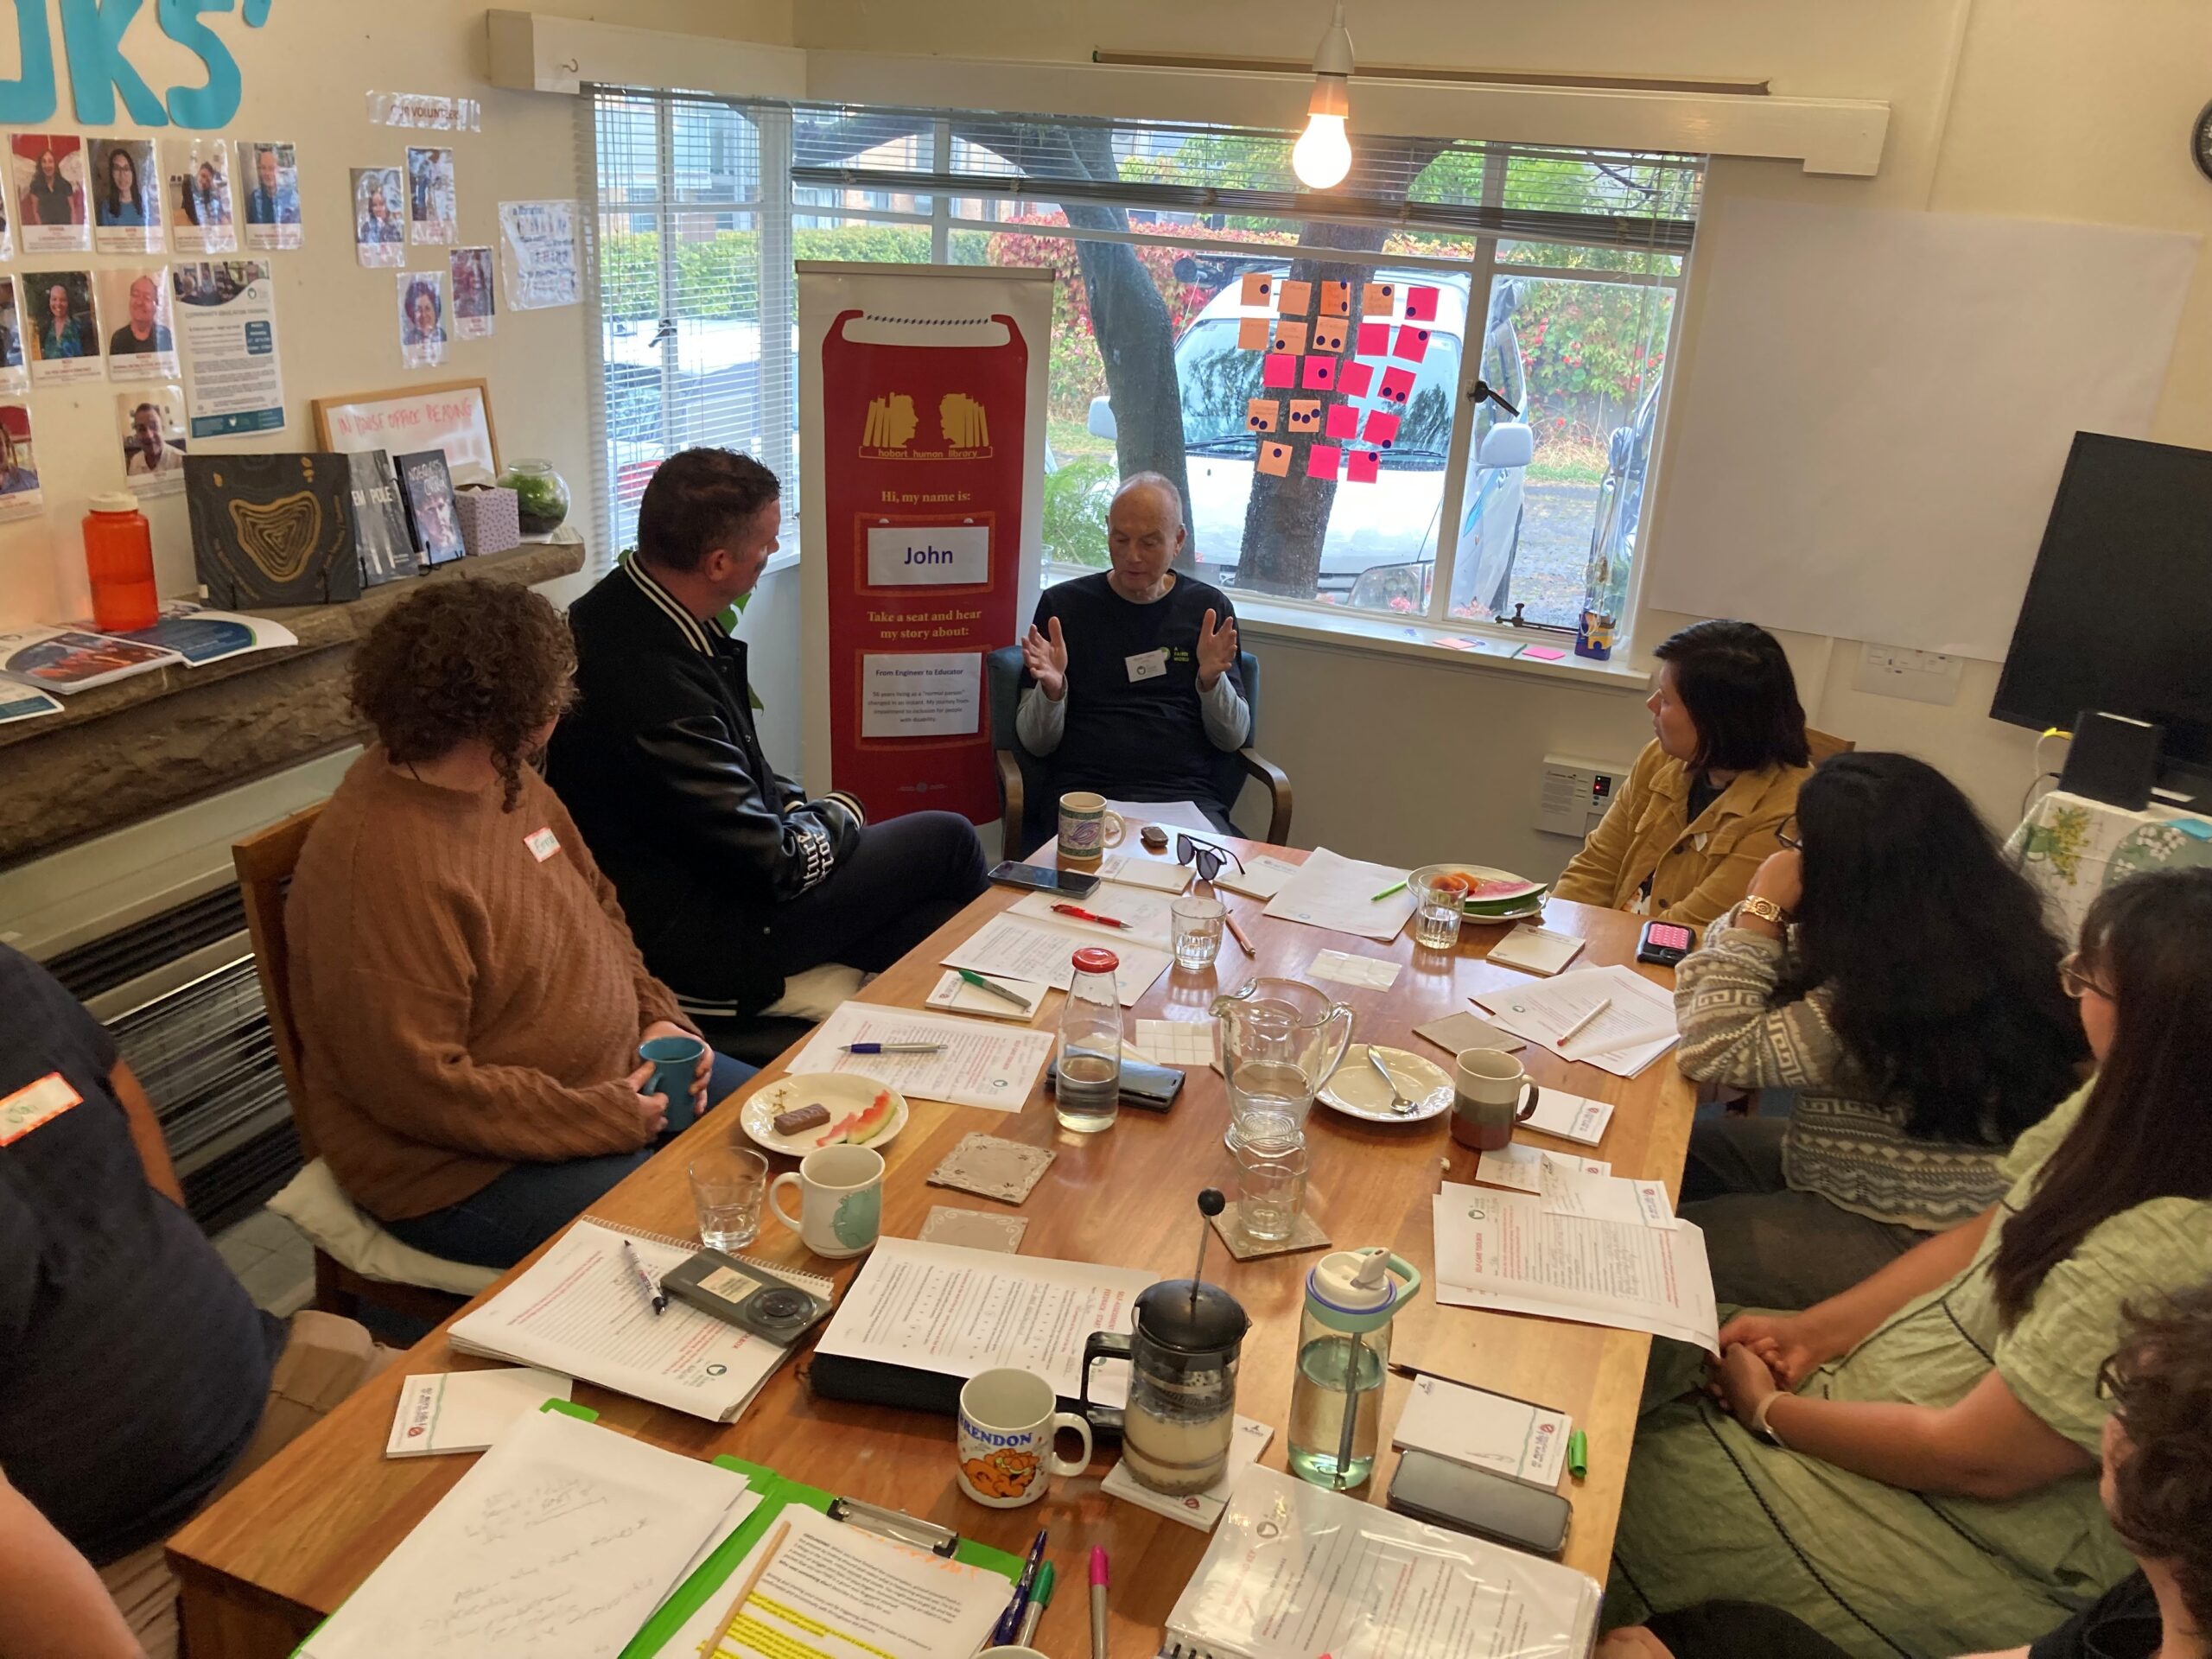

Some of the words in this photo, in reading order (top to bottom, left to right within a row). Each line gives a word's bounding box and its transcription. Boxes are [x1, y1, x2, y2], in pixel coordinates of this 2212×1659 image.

[338, 417, 352, 435] IN
[388, 409, 420, 429] OFFICE
[878, 448, 908, 458] hobart
[913, 449, 944, 458] human
[948, 448, 978, 459] library
[370, 486, 393, 504] POLE
[881, 491, 899, 504] Hi,
[902, 493, 920, 505] my
[922, 493, 955, 502] name
[957, 491, 970, 501] is:
[904, 546, 953, 565] John
[867, 610, 895, 622] Take
[906, 613, 928, 622] seat
[931, 610, 952, 621] and
[956, 609, 982, 620] hear
[880, 631, 898, 641] my
[899, 628, 931, 640] story
[932, 626, 969, 637] about:
